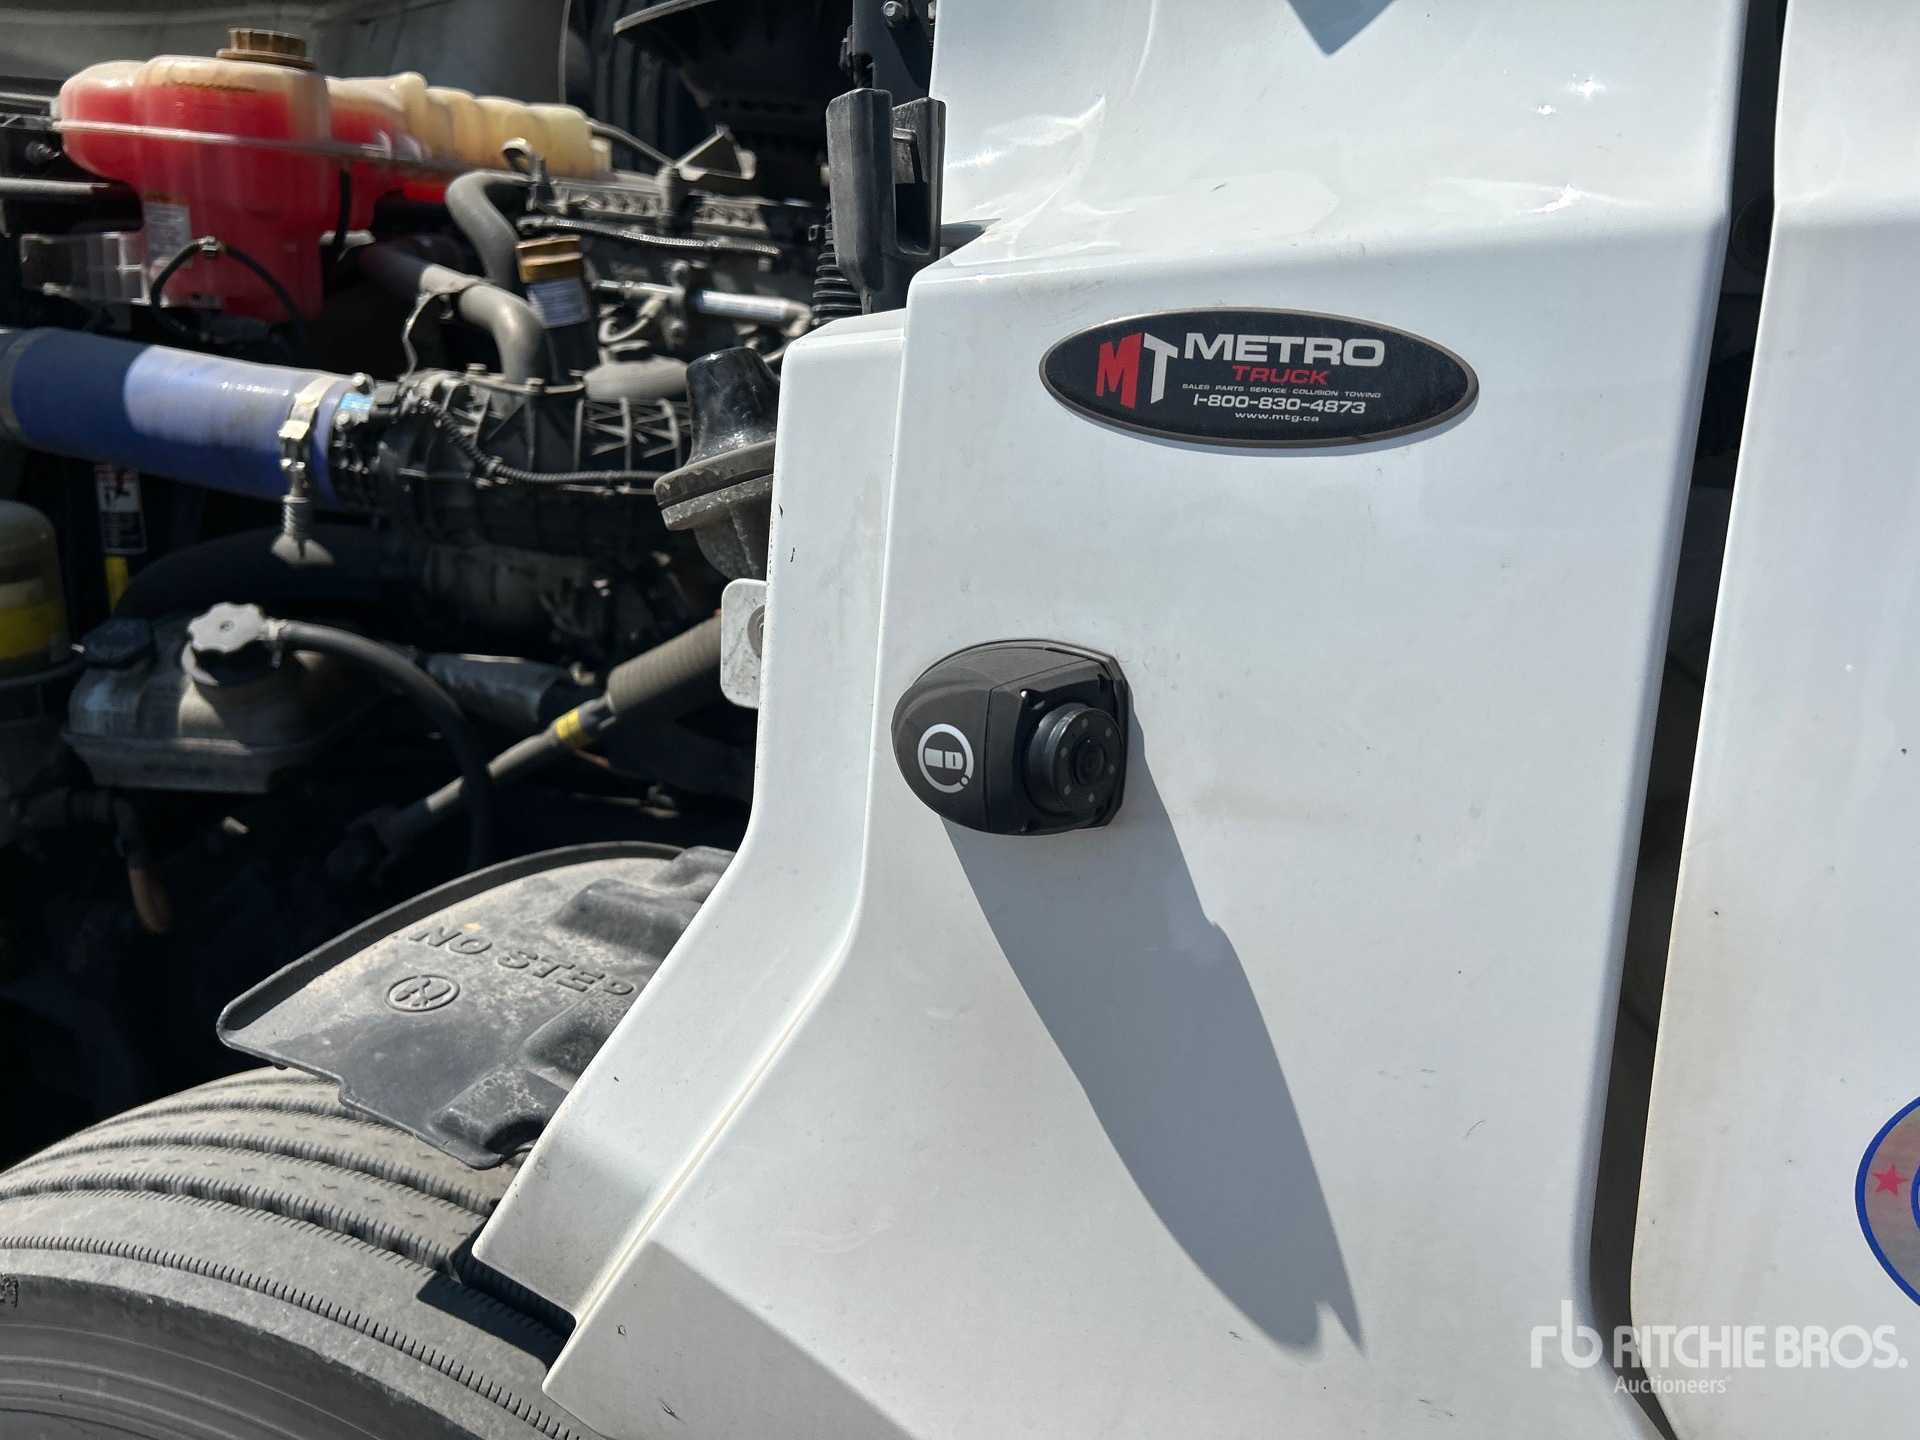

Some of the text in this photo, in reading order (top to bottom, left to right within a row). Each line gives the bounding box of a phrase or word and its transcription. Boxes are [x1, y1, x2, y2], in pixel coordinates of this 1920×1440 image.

[1184, 332, 1385, 367] METRO
[1232, 364, 1330, 385] TRUCK
[1292, 388, 1339, 397] COLLISION
[1193, 393, 1366, 414] 1-800-830-4873
[1235, 412, 1320, 422] www.mtg.ca
[408, 926, 634, 995] NO STEP
